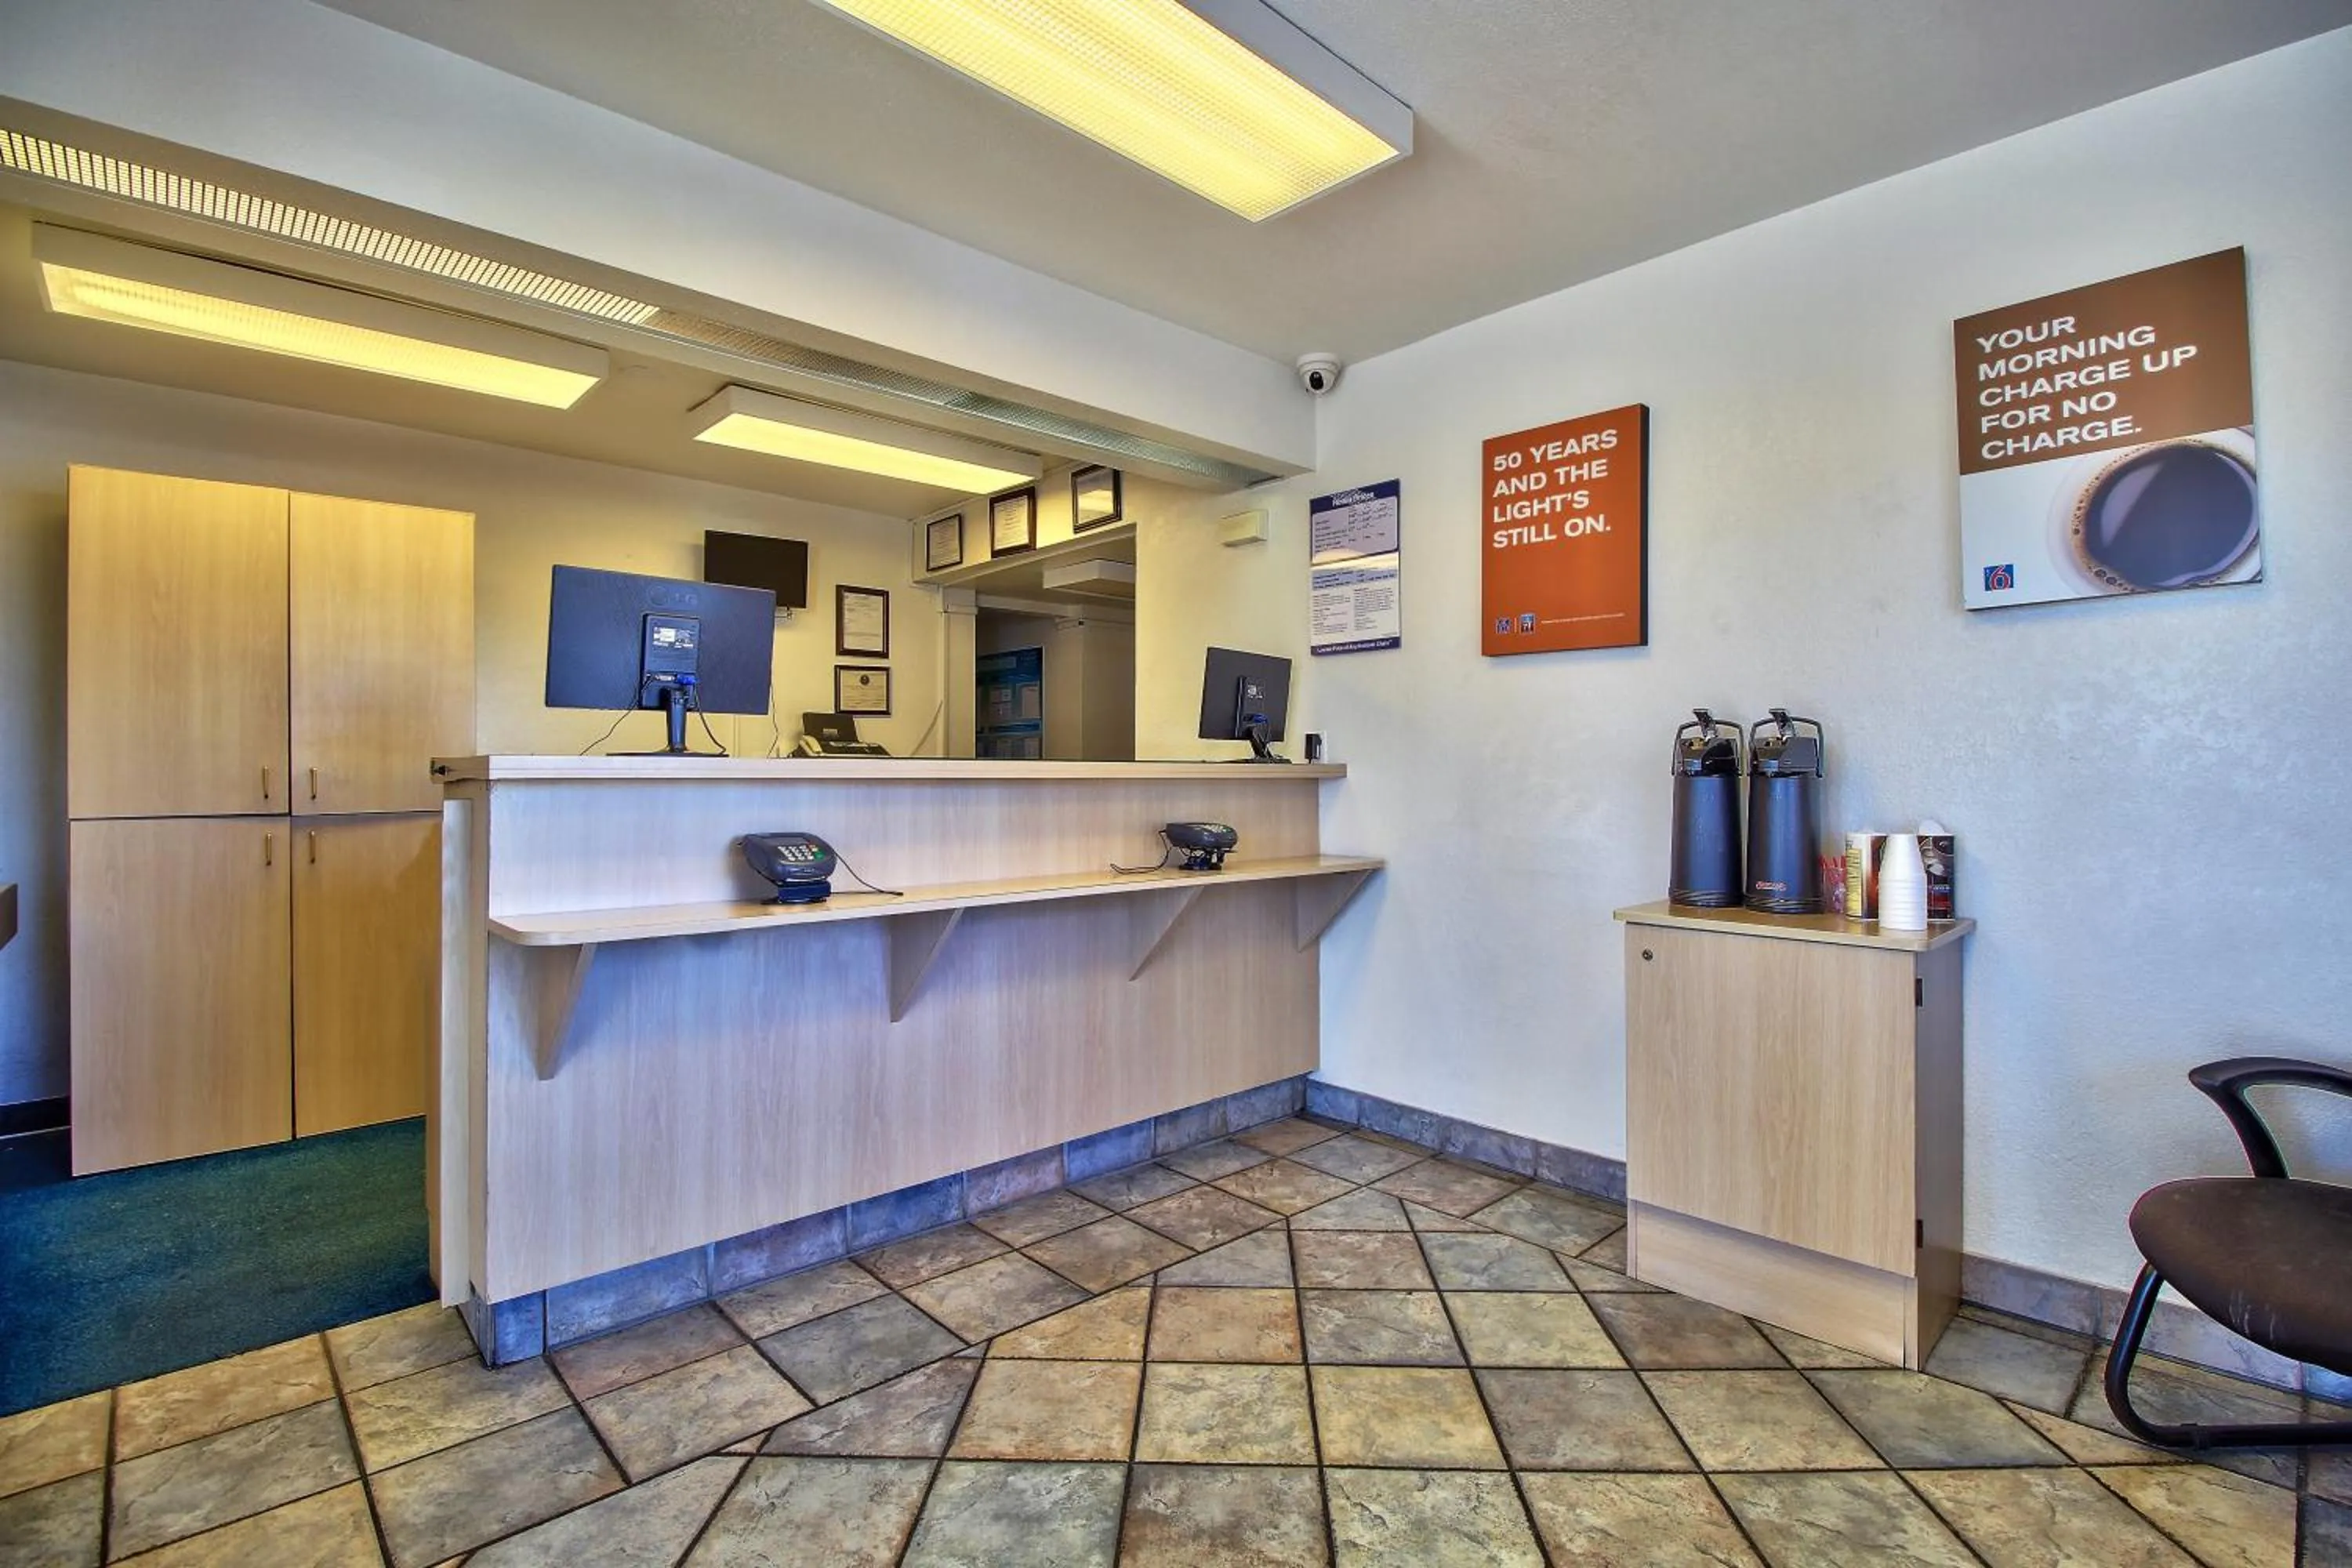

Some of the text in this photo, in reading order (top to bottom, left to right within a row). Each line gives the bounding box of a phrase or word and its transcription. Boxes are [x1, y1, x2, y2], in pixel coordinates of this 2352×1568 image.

[1976, 315, 2076, 354] YOUR
[1978, 325, 2156, 382] MORNING
[1980, 345, 2198, 407] CHARGE UP
[1981, 391, 2117, 434] FOR NO
[1494, 429, 1617, 471] 50 YEARS
[1981, 416, 2143, 460] CHARGE.
[1493, 459, 1608, 498] AND THE
[1493, 490, 1589, 523] LIGHT'S
[1493, 514, 1611, 548] STILL ON.
